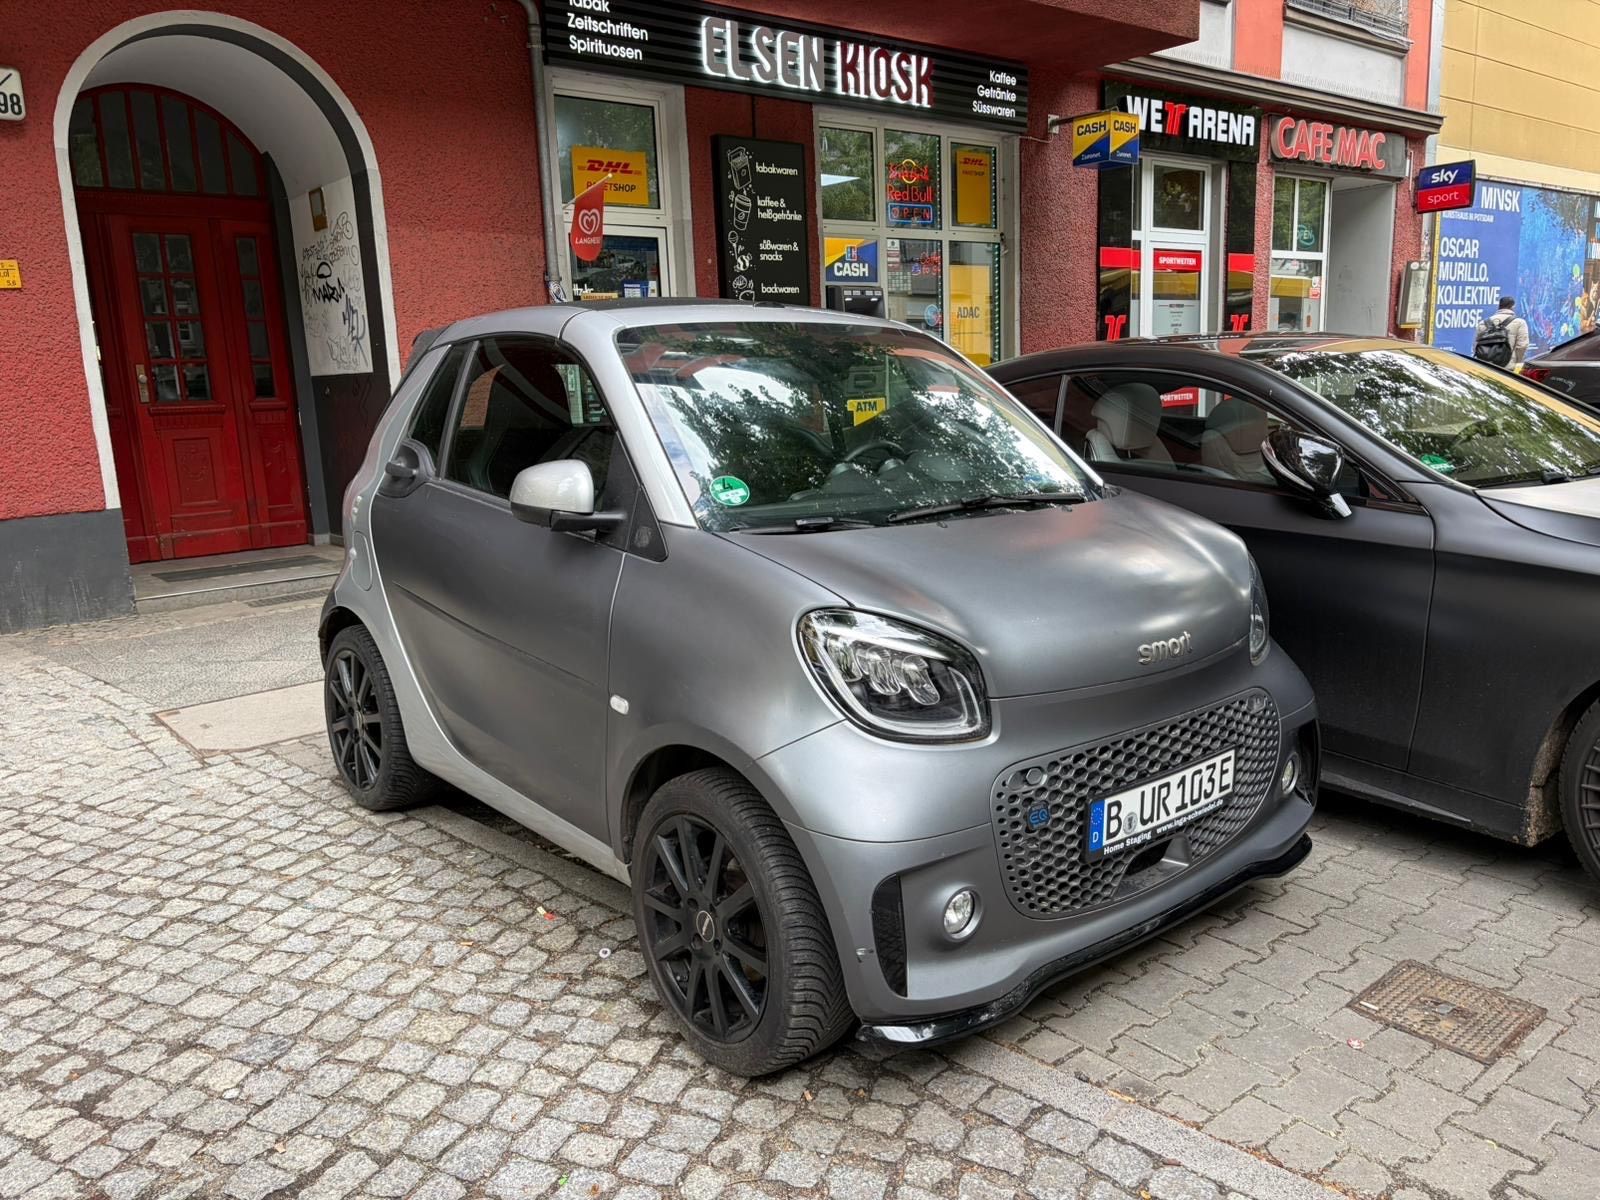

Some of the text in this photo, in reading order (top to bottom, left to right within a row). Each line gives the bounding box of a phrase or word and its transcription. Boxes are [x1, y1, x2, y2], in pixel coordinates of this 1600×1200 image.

[567, 12, 649, 41] Zeitschriften
[569, 34, 643, 61] Spirituosen
[701, 16, 933, 108] ELSEN KIOSK
[989, 69, 1017, 86] Kaffee
[976, 84, 1017, 102] Getränke
[972, 100, 1016, 118] Süsswaren
[1076, 120, 1107, 137] CASH
[1113, 119, 1137, 134] CASH
[1188, 106, 1255, 147] ARENA
[1274, 116, 1386, 170] CAFE MAC
[587, 159, 634, 175] DHL
[755, 162, 798, 176] tabakwaren
[963, 157, 985, 166] DHL
[1431, 168, 1459, 184] sky
[887, 183, 932, 202] Red Bull
[1427, 191, 1459, 205] sport
[1481, 186, 1520, 212] MINSK
[757, 195, 786, 208] kaffee &
[757, 211, 802, 222] heißgetränke
[892, 207, 930, 219] OPEN
[759, 239, 799, 251] süßwaren &
[1440, 237, 1480, 258] OSCAR
[759, 252, 783, 262] snacks
[834, 262, 869, 277] CASH
[1438, 261, 1489, 282] MURILLO.
[761, 283, 800, 294] backwaren
[1437, 285, 1500, 305] KOLLEKTIVE
[957, 306, 980, 319] ADAC
[1435, 308, 1484, 329] OSMOSE
[856, 401, 877, 412] ATM
[1137, 631, 1193, 664] smart
[1105, 755, 1232, 841] B UR 103E
[1029, 807, 1049, 825] EQ
[1092, 831, 1099, 843] D
[1103, 842, 1125, 856] Home
[1125, 831, 1152, 847] Staging
